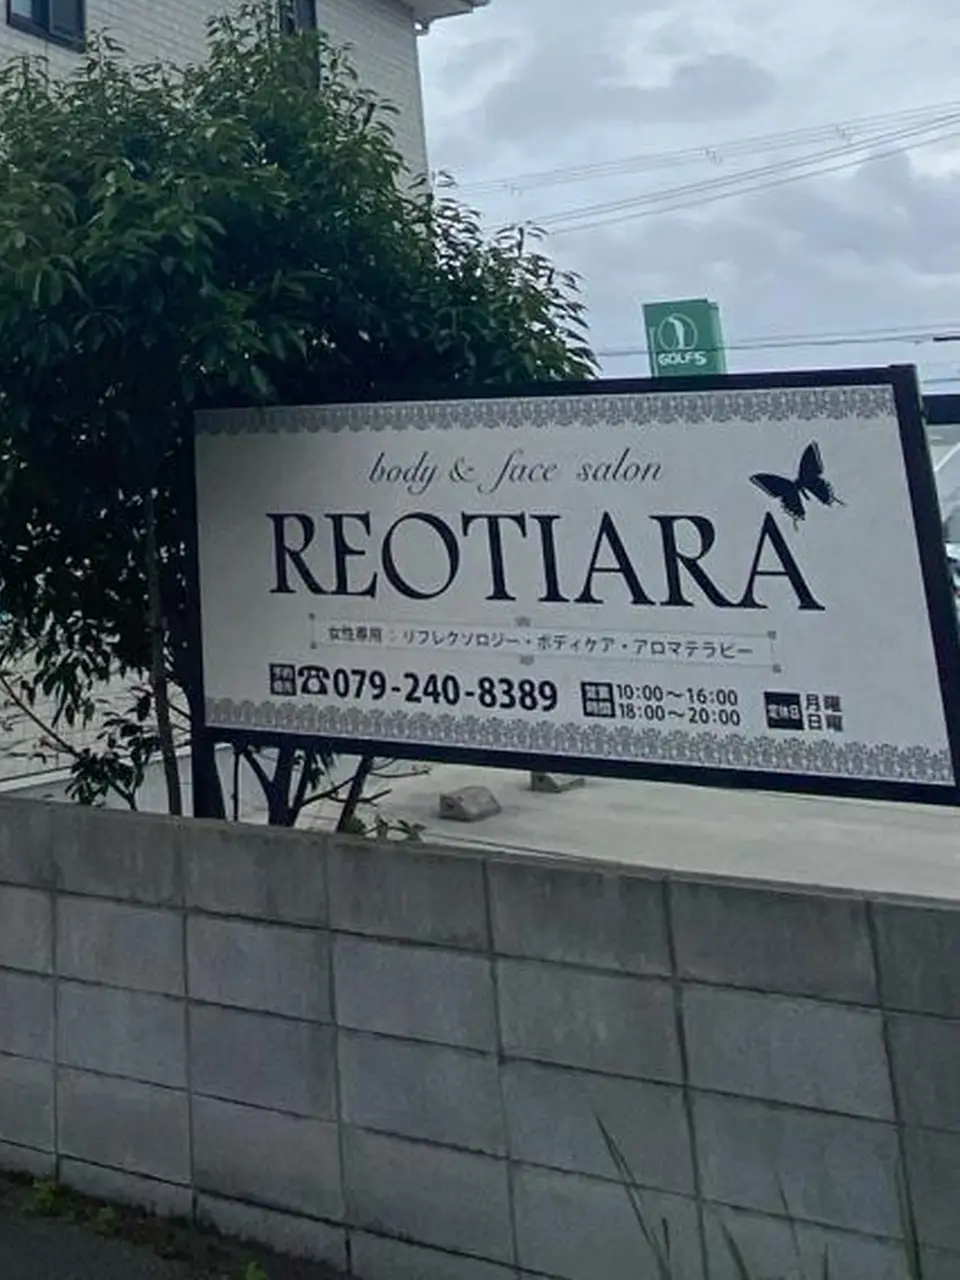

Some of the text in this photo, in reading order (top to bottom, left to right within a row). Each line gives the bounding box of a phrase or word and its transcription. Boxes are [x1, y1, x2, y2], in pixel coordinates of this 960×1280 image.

[368, 447, 664, 496] body & face salon
[265, 510, 827, 611] REOTIARA
[332, 667, 558, 713] 079-240-8389
